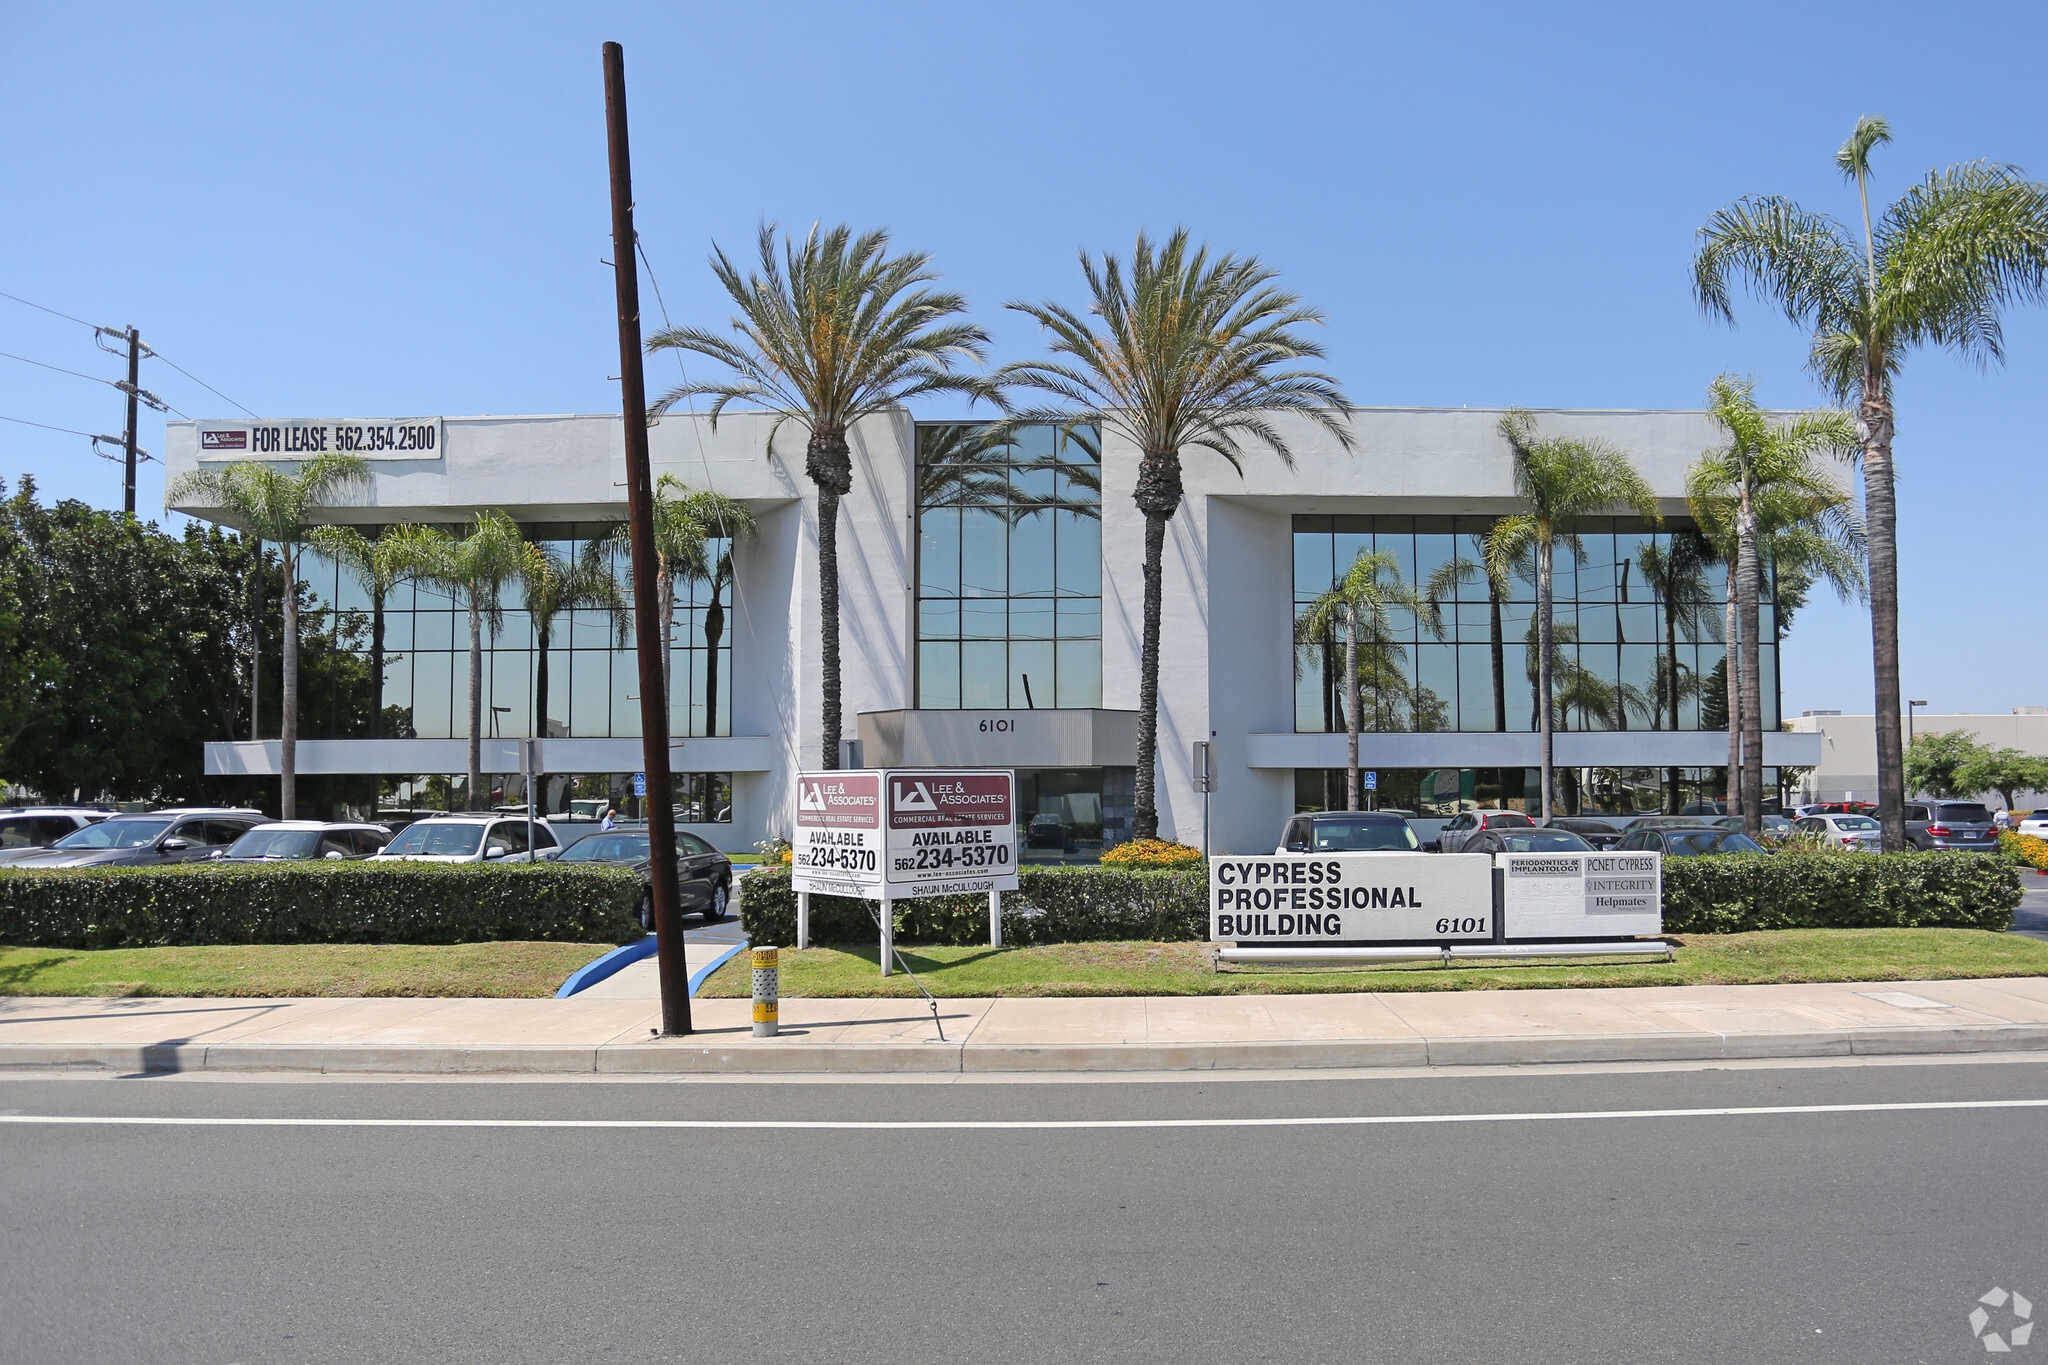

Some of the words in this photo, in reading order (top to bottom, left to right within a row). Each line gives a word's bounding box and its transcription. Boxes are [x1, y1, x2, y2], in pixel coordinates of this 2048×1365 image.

[252, 427, 280, 452] FOR
[284, 426, 327, 452] LEASE
[335, 425, 435, 451] 562.354.2500
[979, 719, 1014, 732] 6101
[823, 783, 837, 795] LEE
[838, 782, 845, 795] &
[932, 782, 953, 794] LEE
[955, 781, 965, 793] &
[939, 794, 1004, 805] ASSOCIATES
[853, 816, 874, 824] SERVICES
[893, 815, 936, 824] COMMERCIAL
[977, 813, 1005, 821] SERVICES
[809, 831, 864, 847] AVAILABLE
[912, 830, 992, 847] AVAILABLE
[797, 853, 811, 866] 562
[811, 847, 876, 871] 234-5370
[894, 857, 915, 871] 562
[916, 844, 1009, 870] 234-5370
[1511, 865, 1579, 873] IMPLANTOLOGY
[1587, 859, 1616, 871] PCNET
[1618, 858, 1653, 871] CYPRESS
[917, 868, 989, 878] www.lee-associates.com
[1218, 861, 1342, 885] CYPRESS
[912, 884, 940, 896] SHAUN
[942, 881, 994, 894] McCULLOUGH
[1593, 880, 1655, 891] INTEGRITY
[1218, 887, 1422, 910] PROFESSIONAL
[1596, 897, 1647, 908] Helpmates
[1218, 913, 1341, 936] BUILDING
[1435, 917, 1486, 934] 6101
